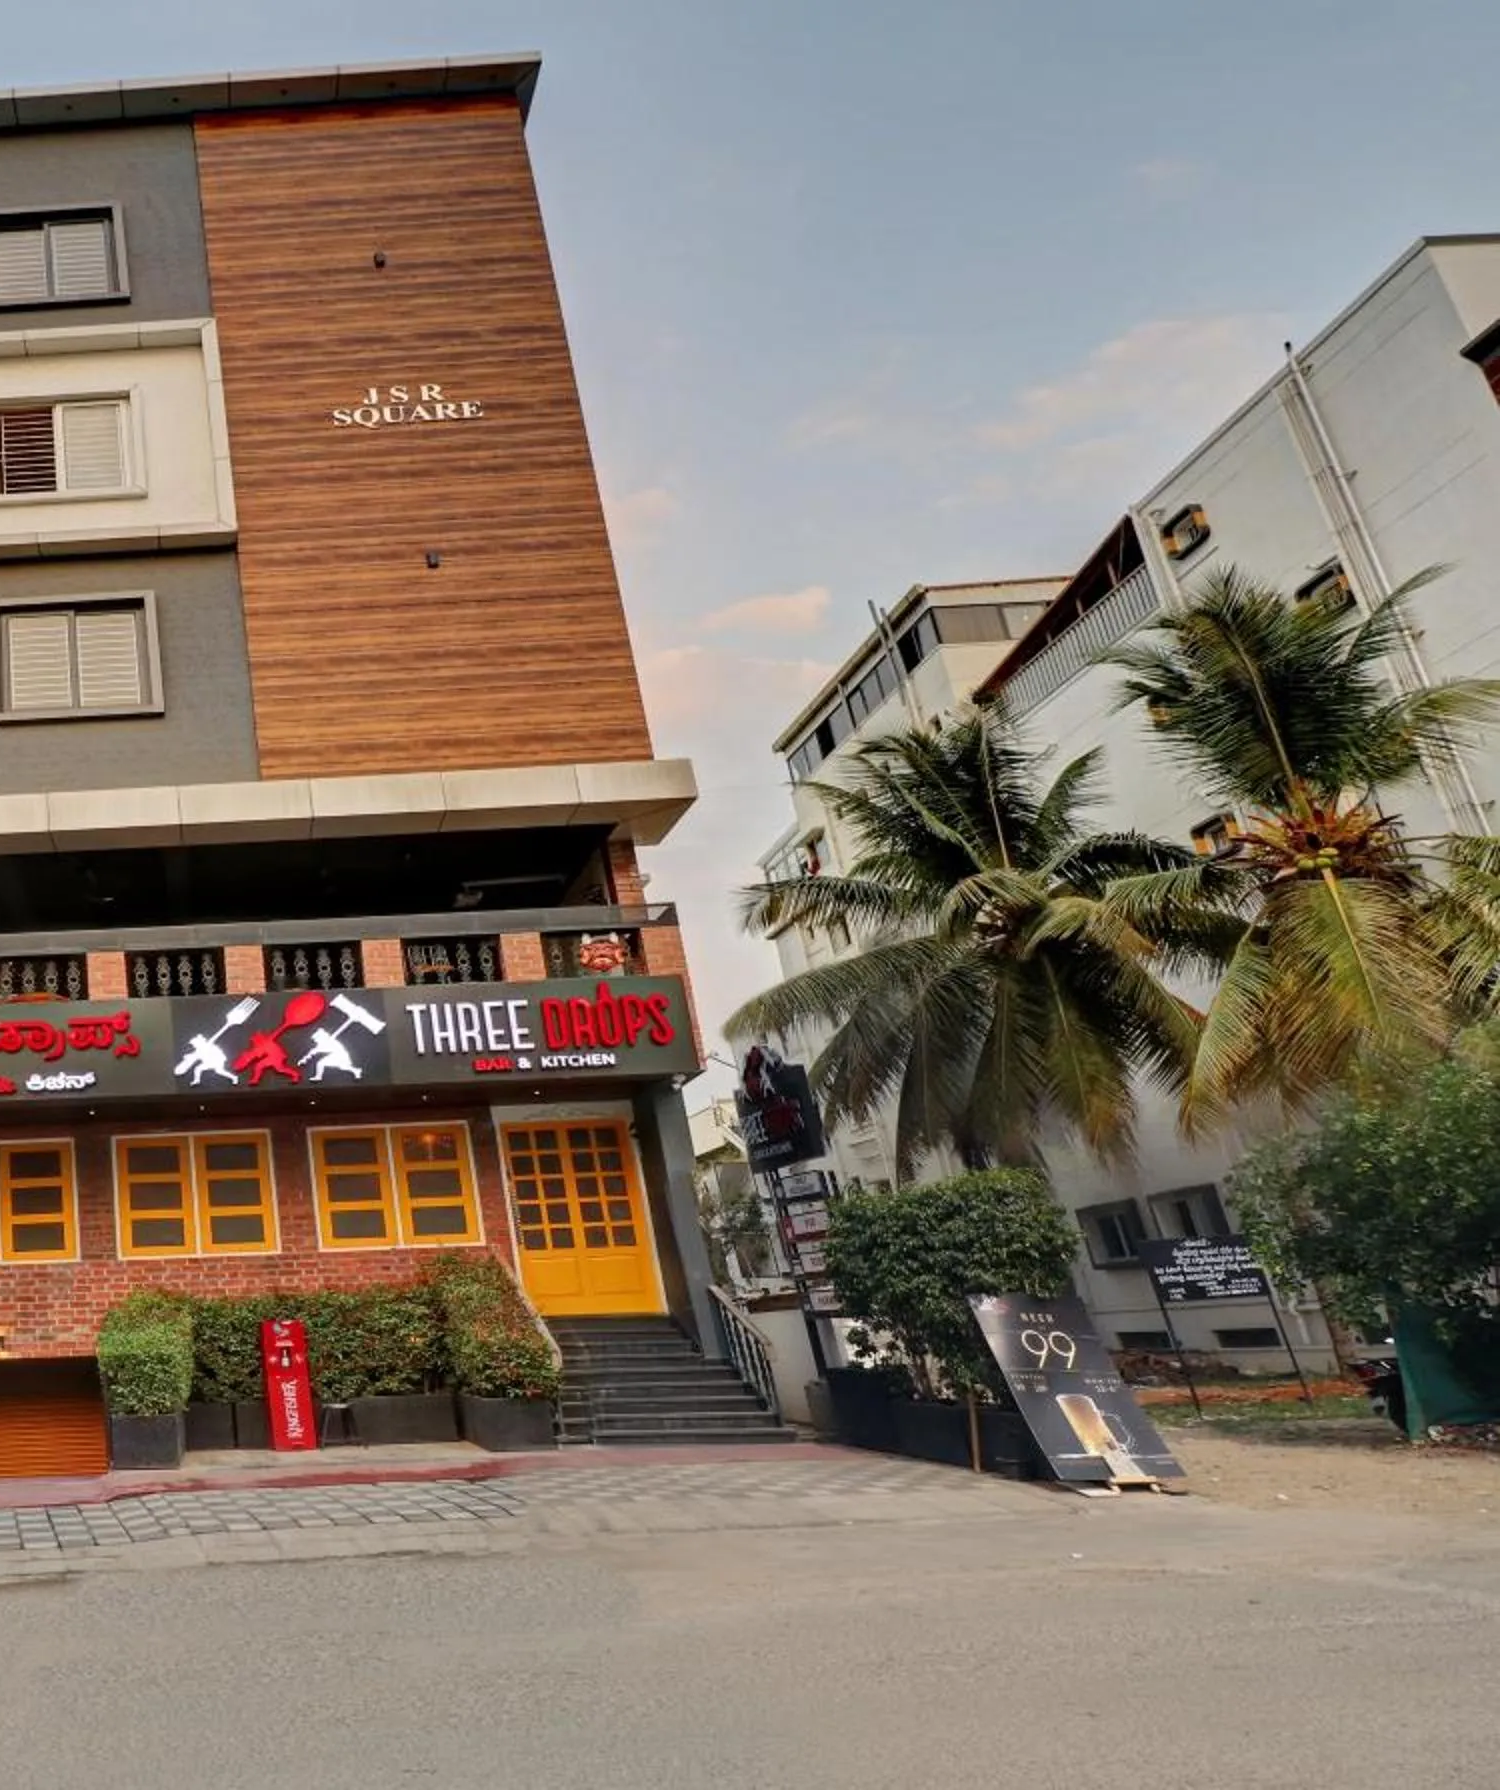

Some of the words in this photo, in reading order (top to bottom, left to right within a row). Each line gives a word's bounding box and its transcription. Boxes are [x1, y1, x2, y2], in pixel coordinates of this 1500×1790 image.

[332, 400, 485, 430] SQUARE
[405, 999, 536, 1055] THREE
[540, 980, 676, 1050] DROPS
[472, 1056, 515, 1073] BAR
[517, 1056, 532, 1070] &
[541, 1053, 617, 1069] KITCHEN
[1021, 1329, 1076, 1370] 99
